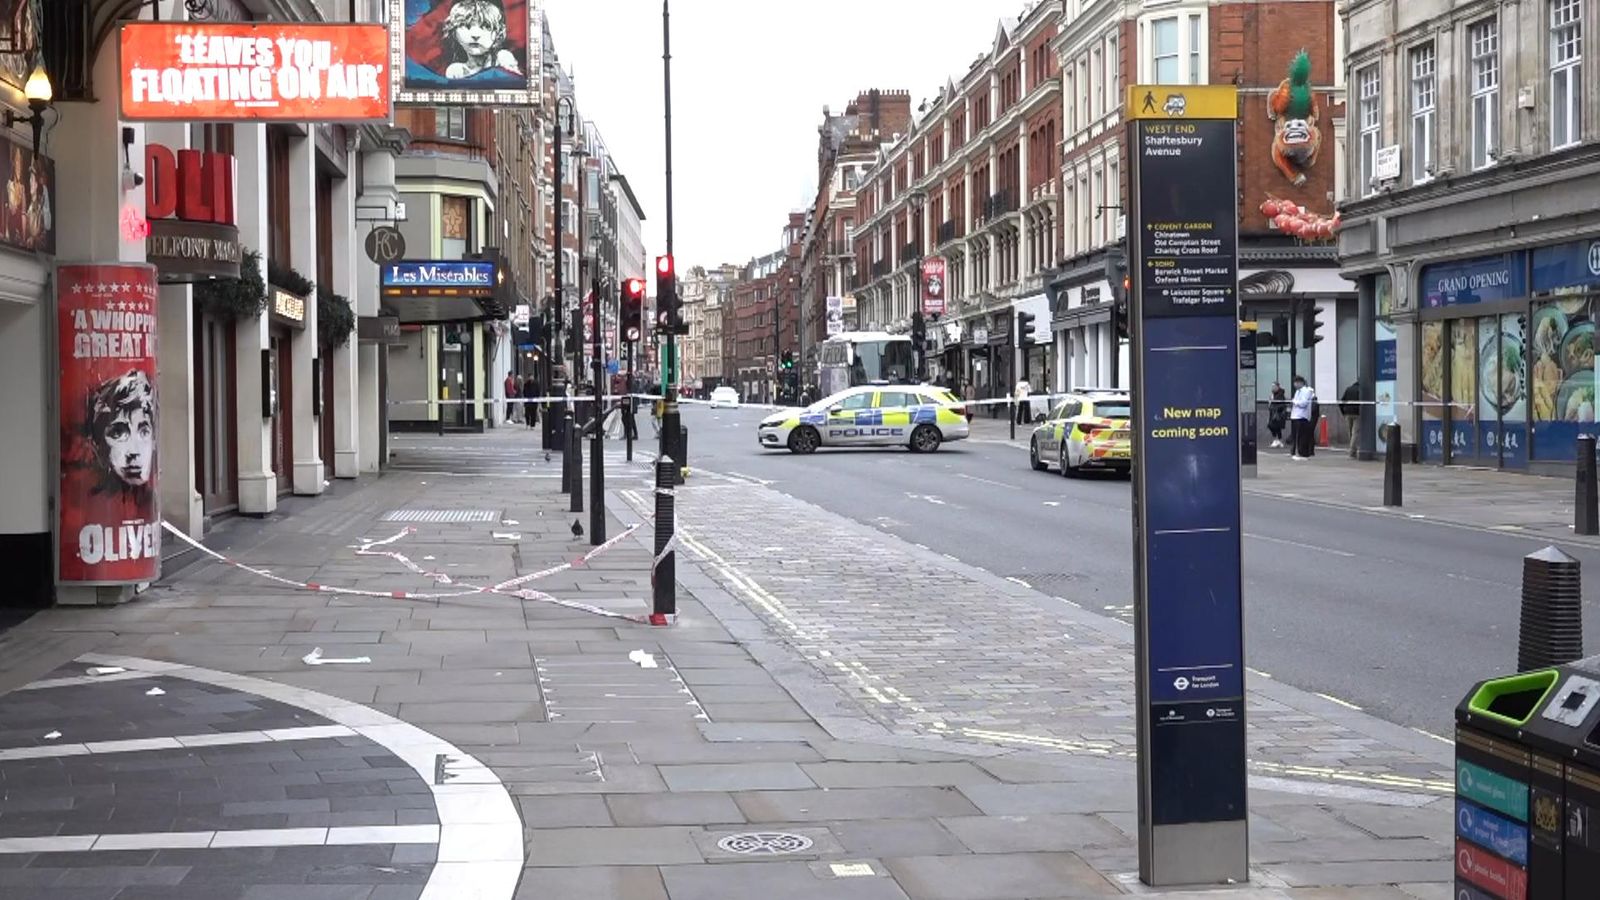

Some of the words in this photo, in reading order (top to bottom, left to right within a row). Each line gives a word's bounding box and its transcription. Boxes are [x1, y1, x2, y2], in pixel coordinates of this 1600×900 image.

[276, 37, 331, 69] YOU
[131, 65, 273, 103] FLOATING
[277, 66, 320, 99] ON
[1145, 124, 1171, 134] WEST
[1175, 124, 1196, 134] END
[1145, 136, 1203, 147] Shaftesbury
[1145, 147, 1181, 156] Avenue
[1154, 223, 1182, 231] COVENT
[1184, 222, 1213, 230] GARDEN
[1154, 231, 1191, 239] Chinatown
[1154, 239, 1167, 247] Old
[1168, 239, 1199, 248] Compton
[1200, 238, 1221, 246] Street
[1154, 247, 1180, 256] Charing
[1181, 246, 1200, 255] Cross
[1201, 246, 1219, 254] Road
[1155, 260, 1176, 268] SOHO
[392, 265, 417, 283] Les
[419, 265, 489, 284] Misérables
[1155, 268, 1181, 276] Berwick
[1182, 267, 1203, 275] Street
[1205, 267, 1229, 275] Market
[1155, 276, 1179, 284] Oxford
[1180, 275, 1202, 283] Street
[1438, 276, 1468, 293] GRAND
[1469, 269, 1509, 289] OPENING
[1201, 288, 1225, 297] Square
[1172, 297, 1200, 305] Trafalgar
[1201, 296, 1225, 305] Square
[73, 330, 142, 359] GREAT
[1163, 407, 1192, 419] New
[1195, 407, 1222, 420] map
[829, 428, 904, 438] POLICE
[1151, 426, 1197, 440] coming
[1199, 426, 1229, 437] soon
